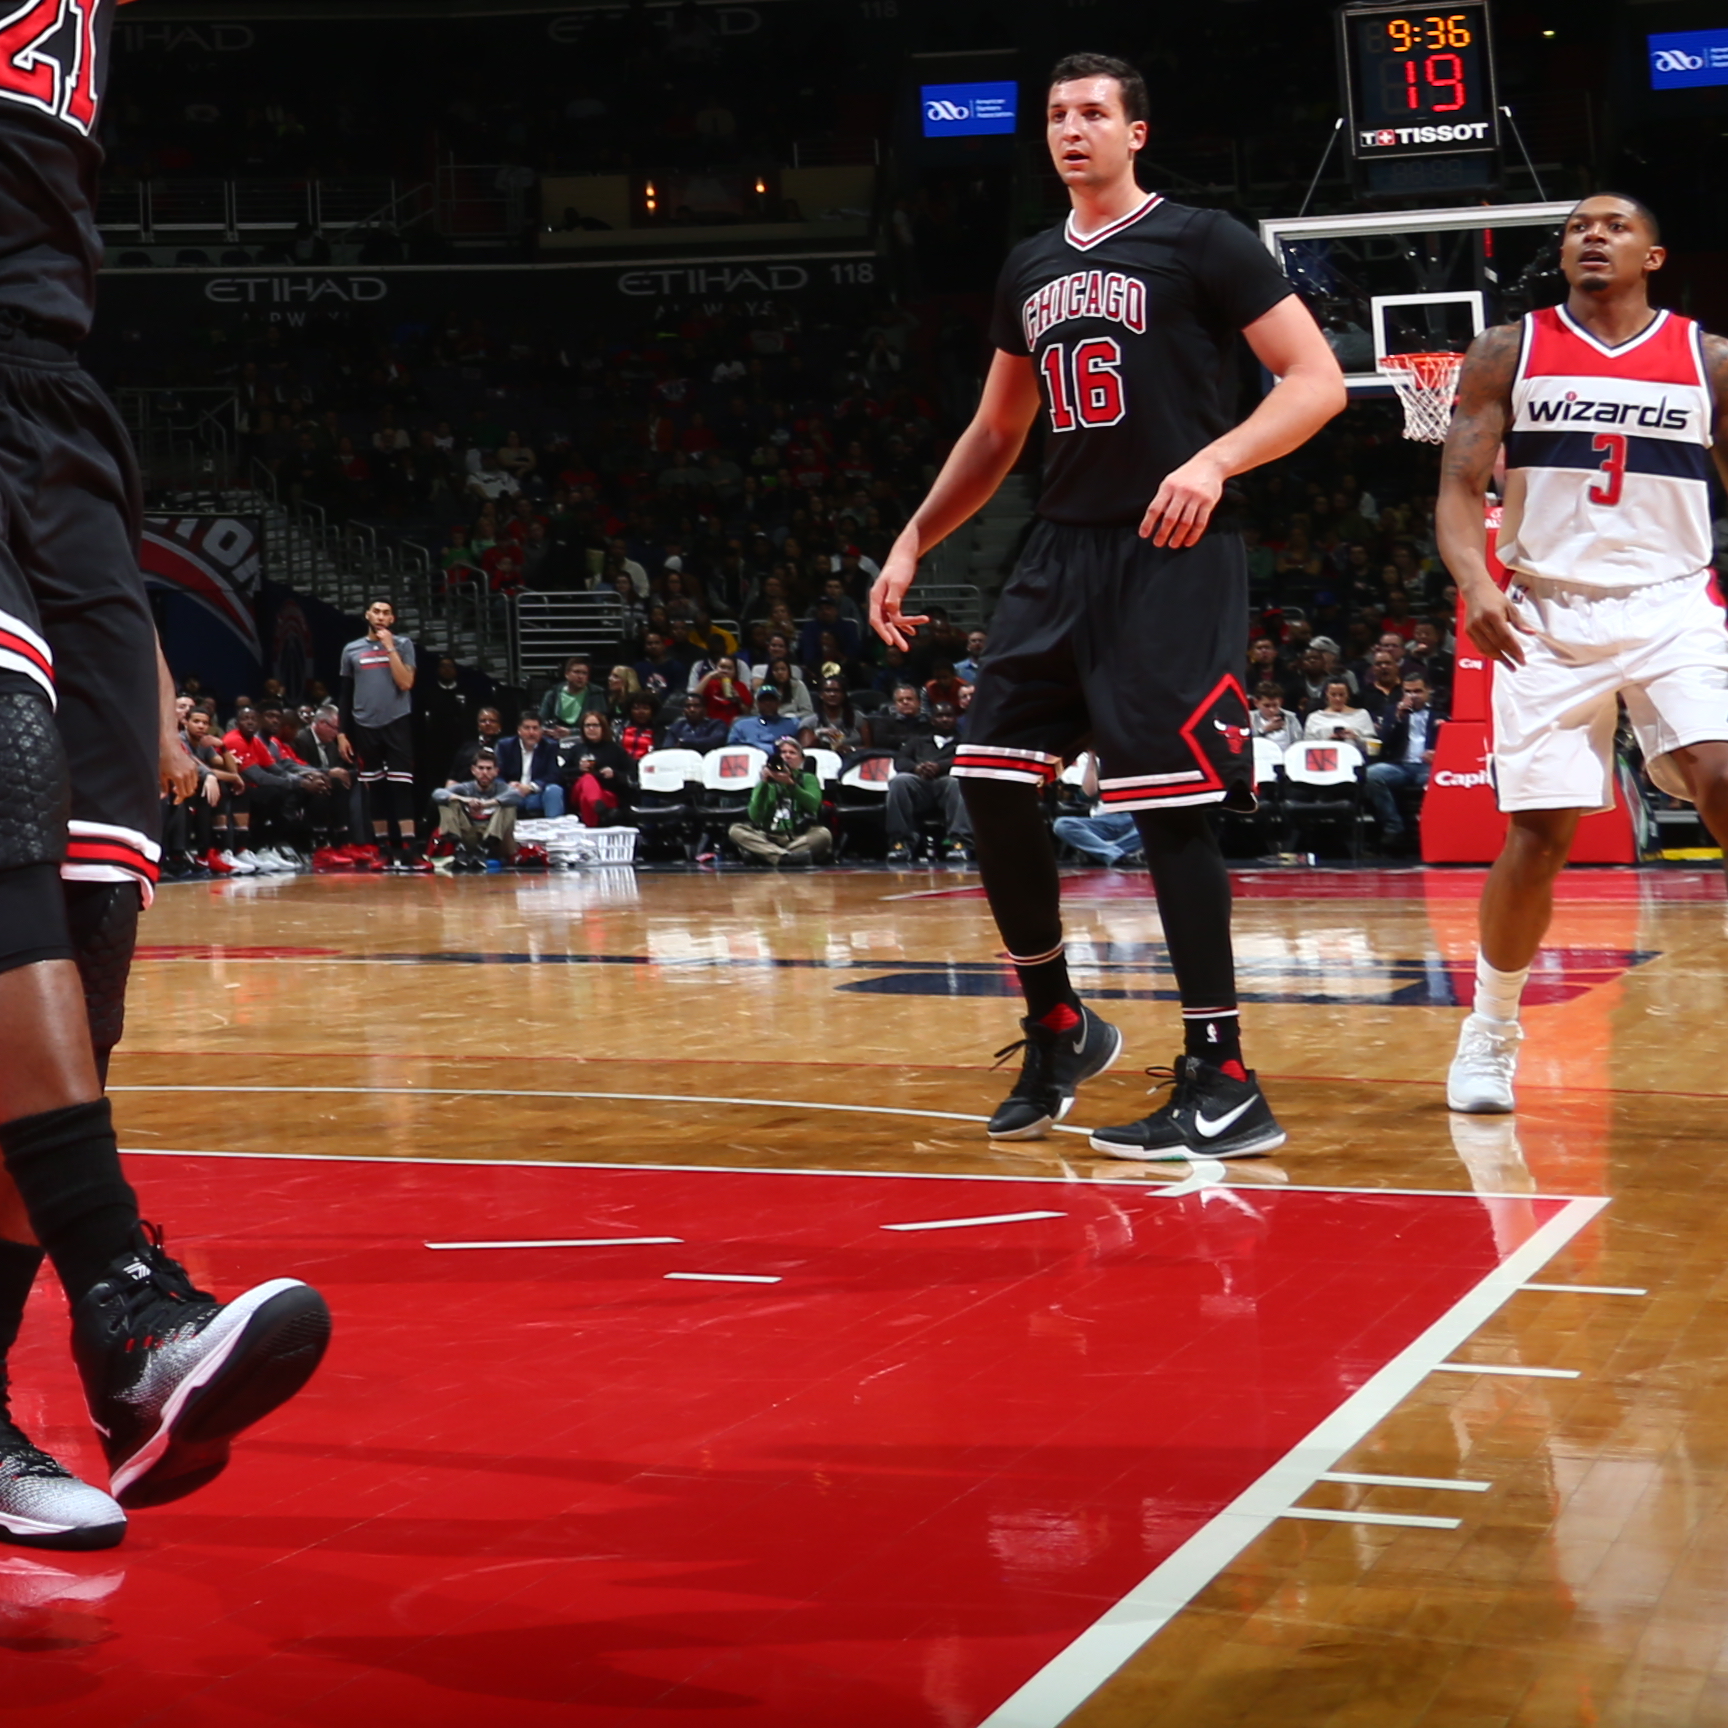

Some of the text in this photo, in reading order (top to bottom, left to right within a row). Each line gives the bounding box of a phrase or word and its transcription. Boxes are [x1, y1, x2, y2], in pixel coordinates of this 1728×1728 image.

[860, 0, 898, 20] 118
[1387, 13, 1474, 53] 9:36
[1404, 52, 1468, 113] 19
[1395, 122, 1489, 145] TISSOT
[204, 276, 388, 303] ETIHAD
[617, 262, 875, 298] ETIHAD 118
[1022, 269, 1147, 352] CHICAGO
[1040, 335, 1126, 434] 16
[1528, 392, 1693, 430] wizards
[1588, 432, 1629, 507] 3
